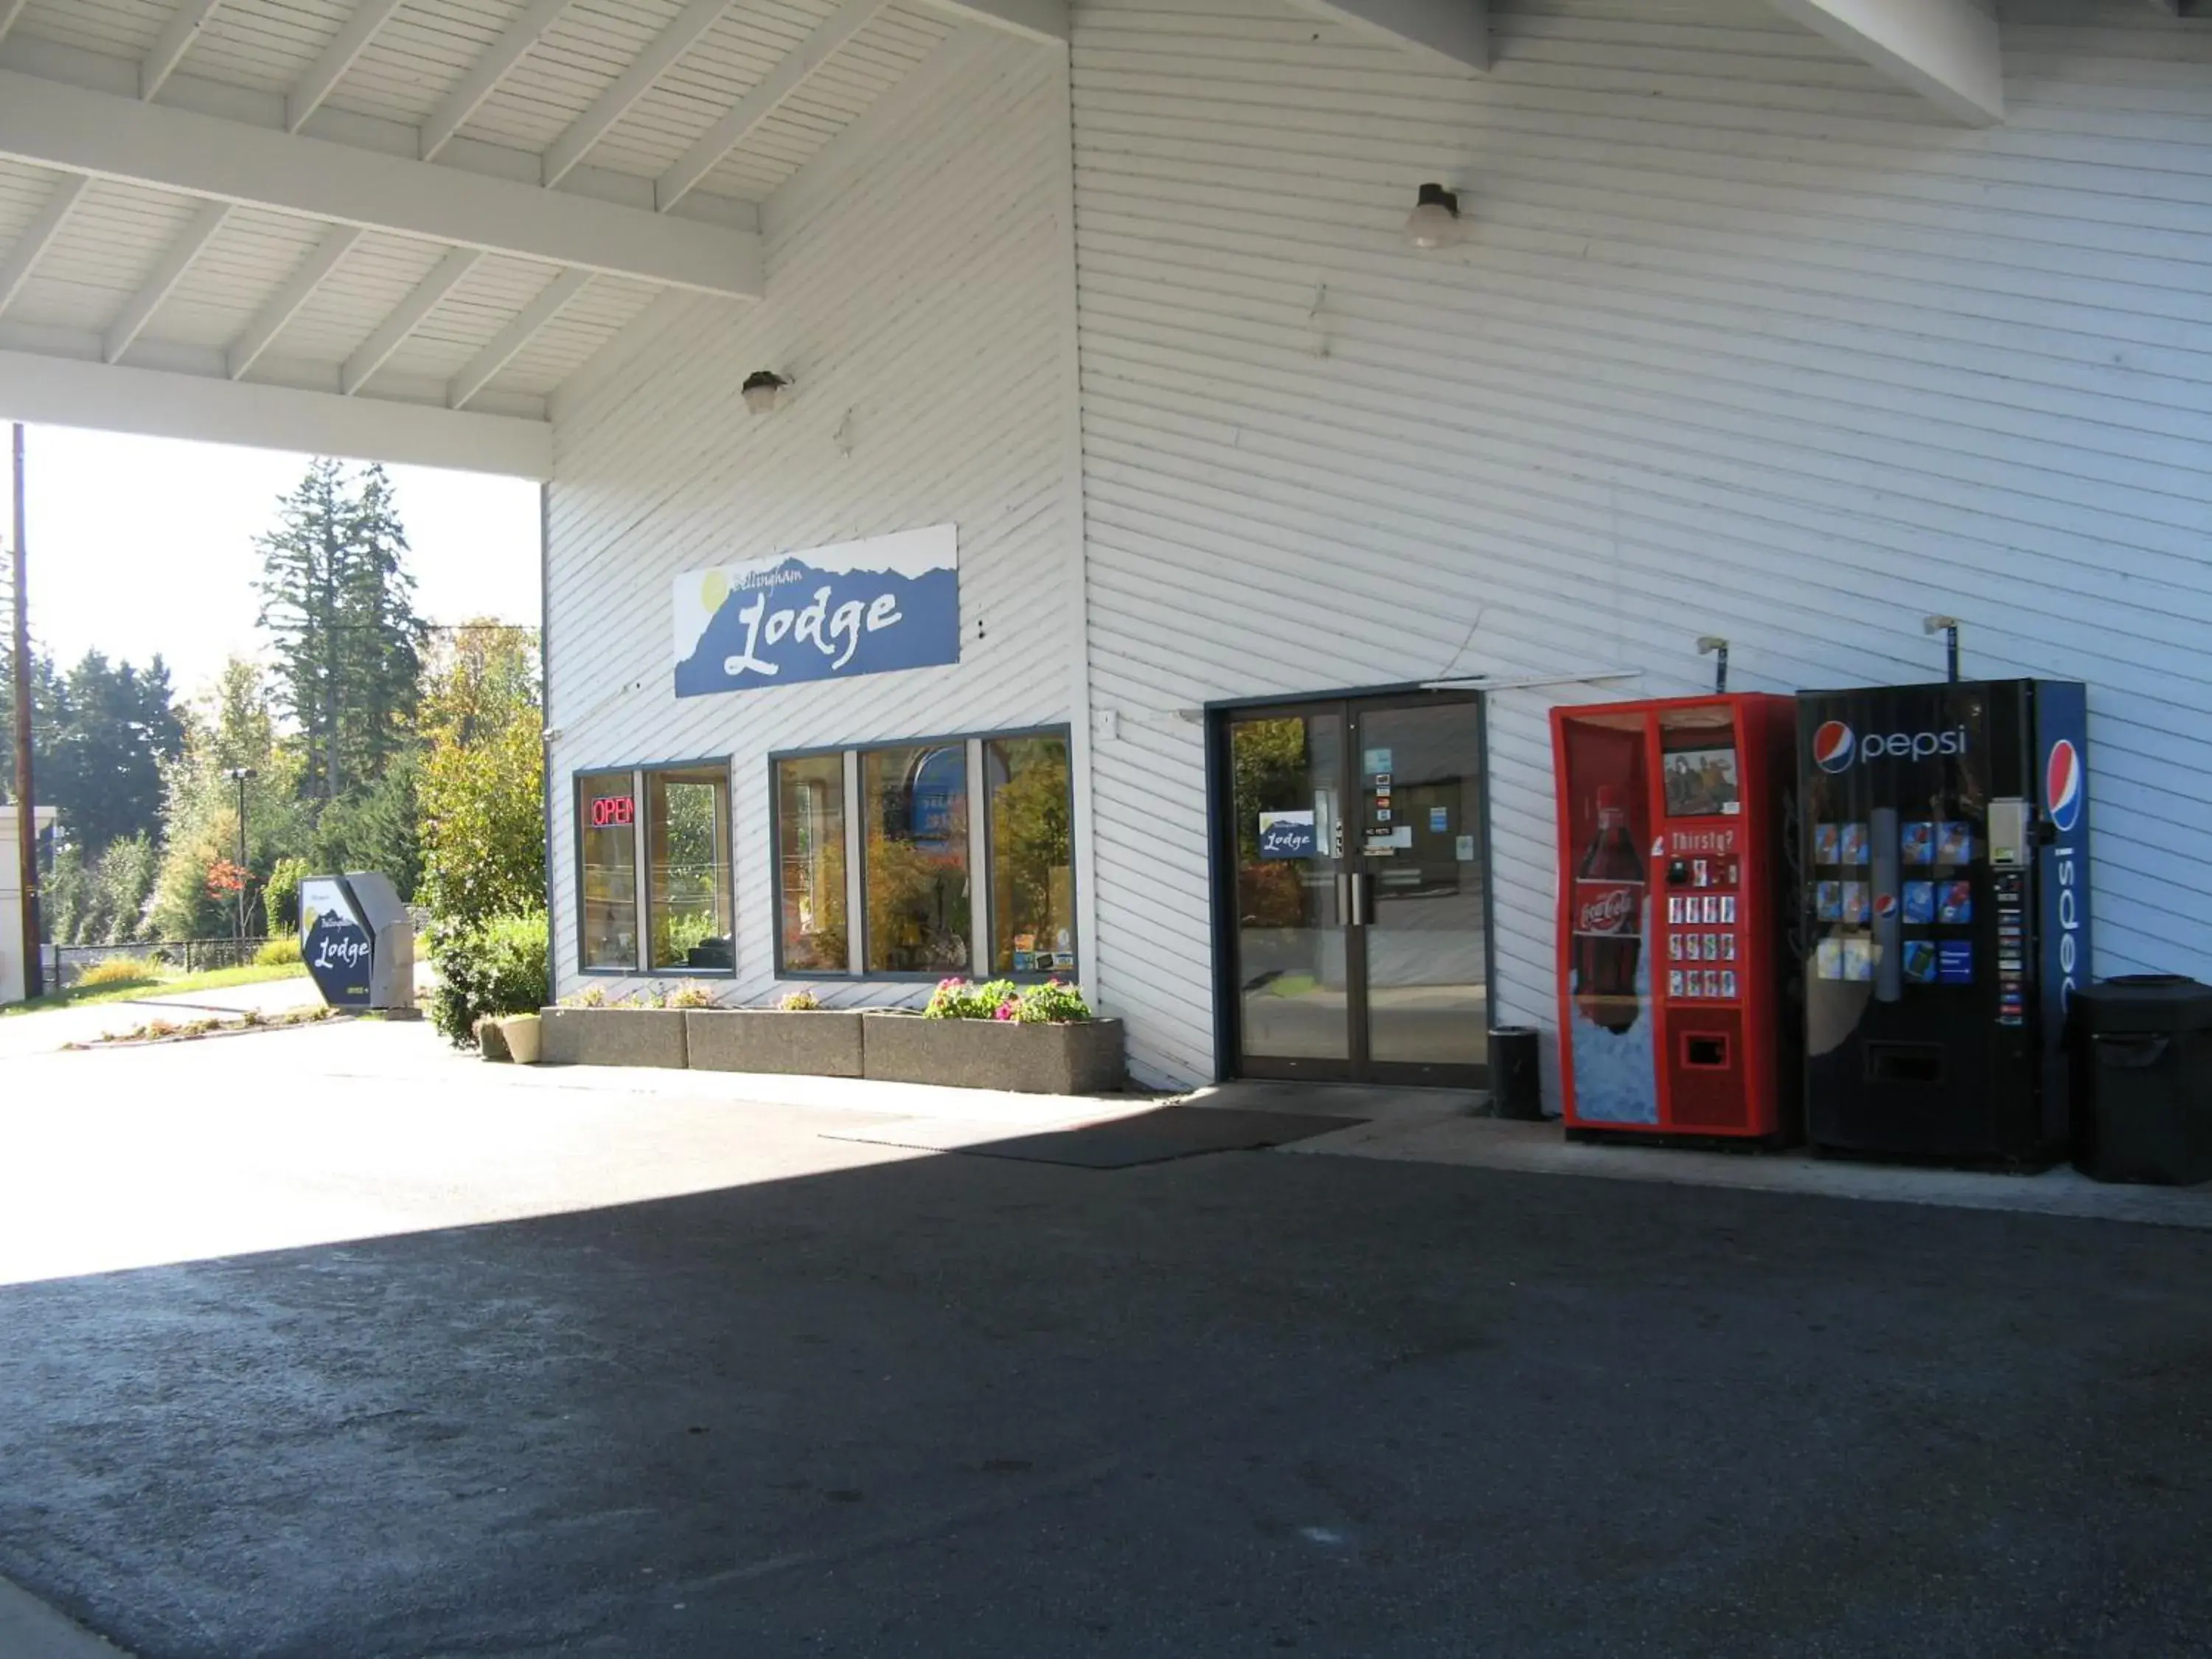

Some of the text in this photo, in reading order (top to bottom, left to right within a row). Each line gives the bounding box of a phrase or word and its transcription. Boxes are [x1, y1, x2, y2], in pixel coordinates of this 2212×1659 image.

[724, 585, 902, 675] Lodge
[1860, 725, 1967, 764] pepsi
[593, 797, 633, 825] OPEN
[1264, 832, 1310, 852] Lodge
[314, 936, 370, 969] Lodge
